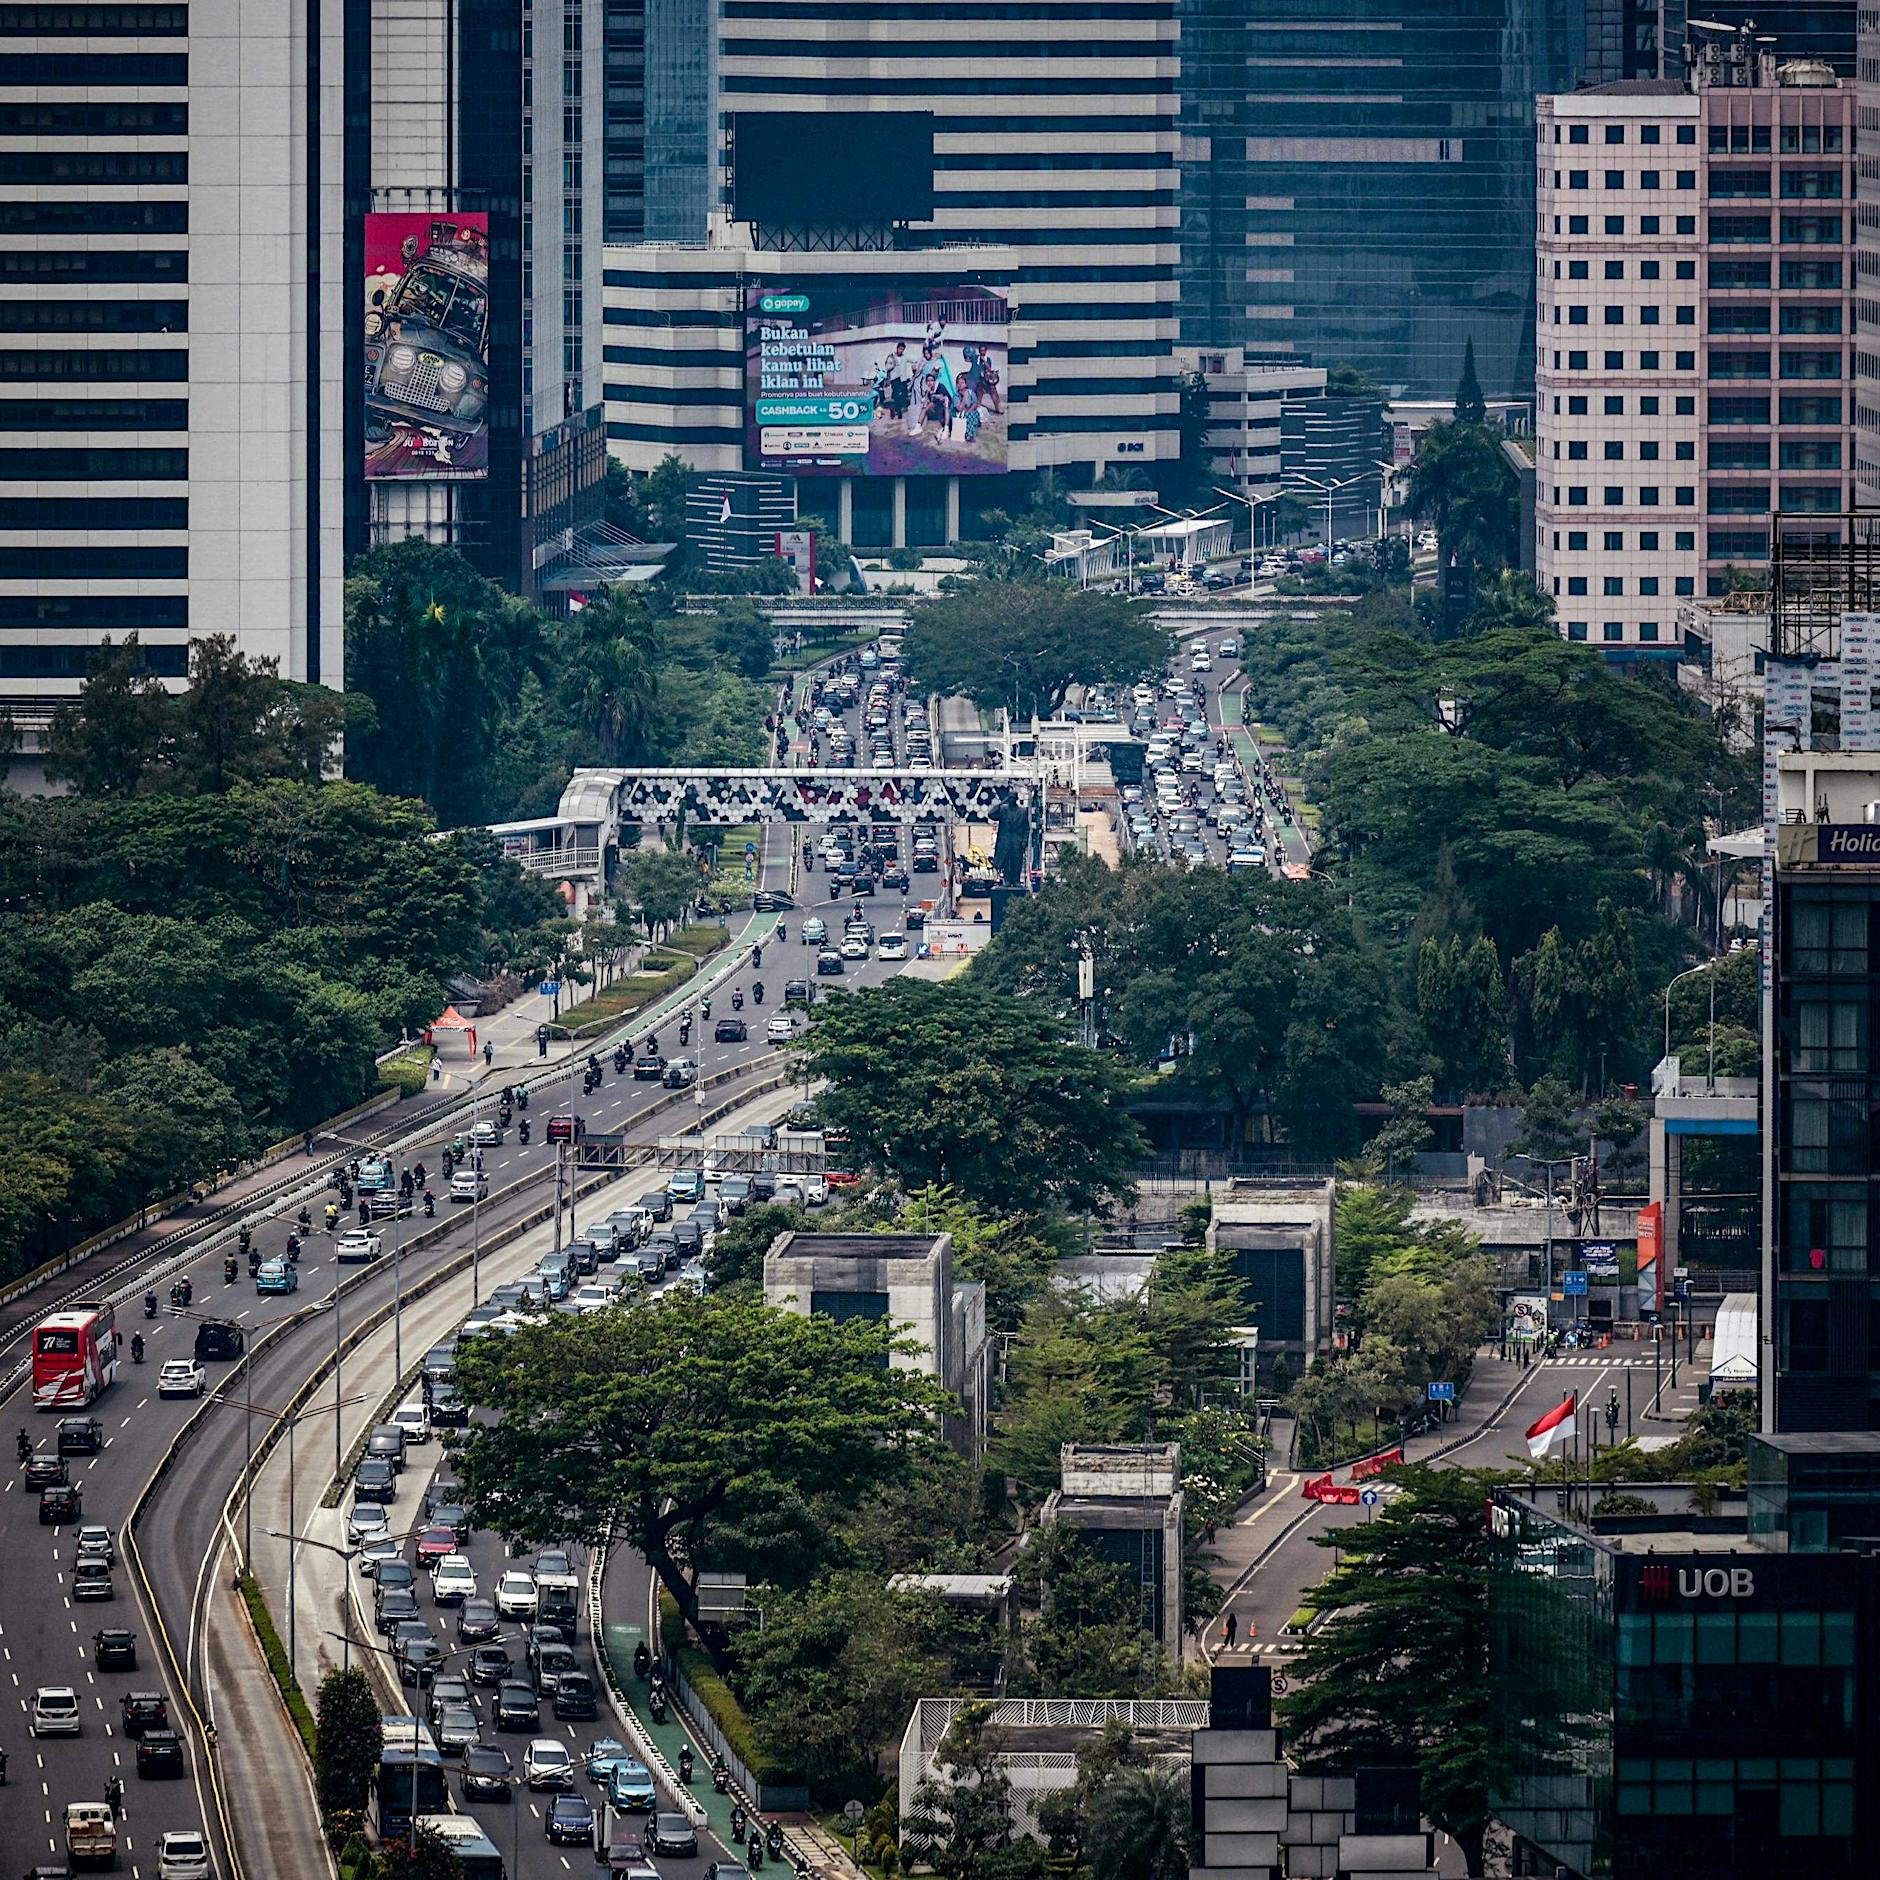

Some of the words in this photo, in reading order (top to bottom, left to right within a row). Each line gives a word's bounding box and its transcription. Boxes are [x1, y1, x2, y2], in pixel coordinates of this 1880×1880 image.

[774, 298, 804, 309] gopay
[760, 327, 809, 340] Bukan
[760, 342, 835, 356] kebetulan
[761, 358, 803, 372] kamu
[806, 358, 841, 371] lihat
[760, 374, 799, 389] iklan
[802, 374, 824, 388] ini
[761, 391, 795, 399] Promonya
[761, 406, 818, 415] CASHBACK
[1678, 1567, 1755, 1598] UOB
